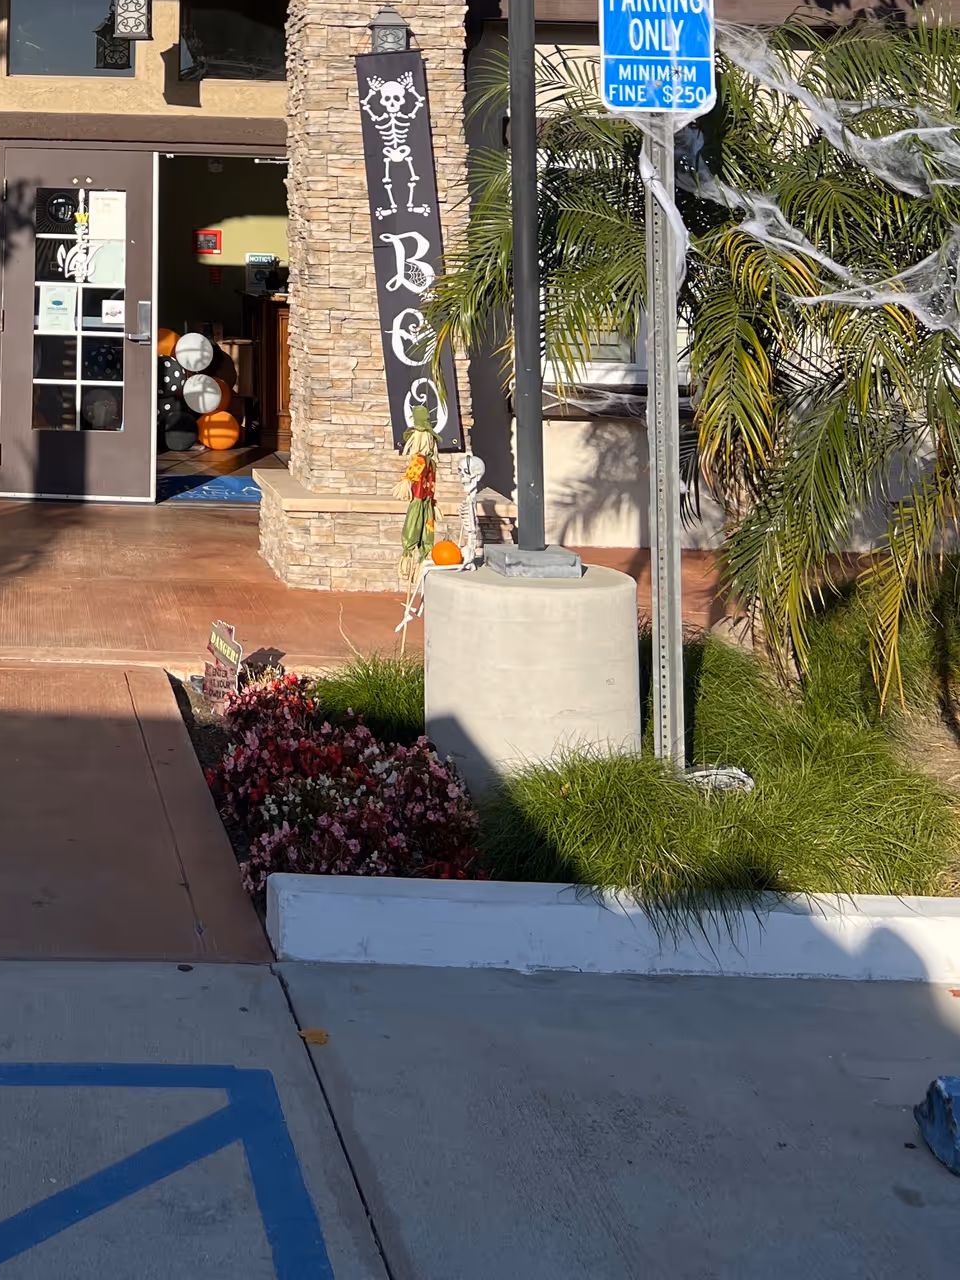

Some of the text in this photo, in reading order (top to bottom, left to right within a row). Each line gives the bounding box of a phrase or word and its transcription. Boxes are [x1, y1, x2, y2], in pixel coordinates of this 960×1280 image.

[628, 18, 685, 52] ONLY
[618, 63, 697, 83] MINIMUM
[609, 84, 707, 105] FINE $250
[210, 631, 240, 665] DANGER!
